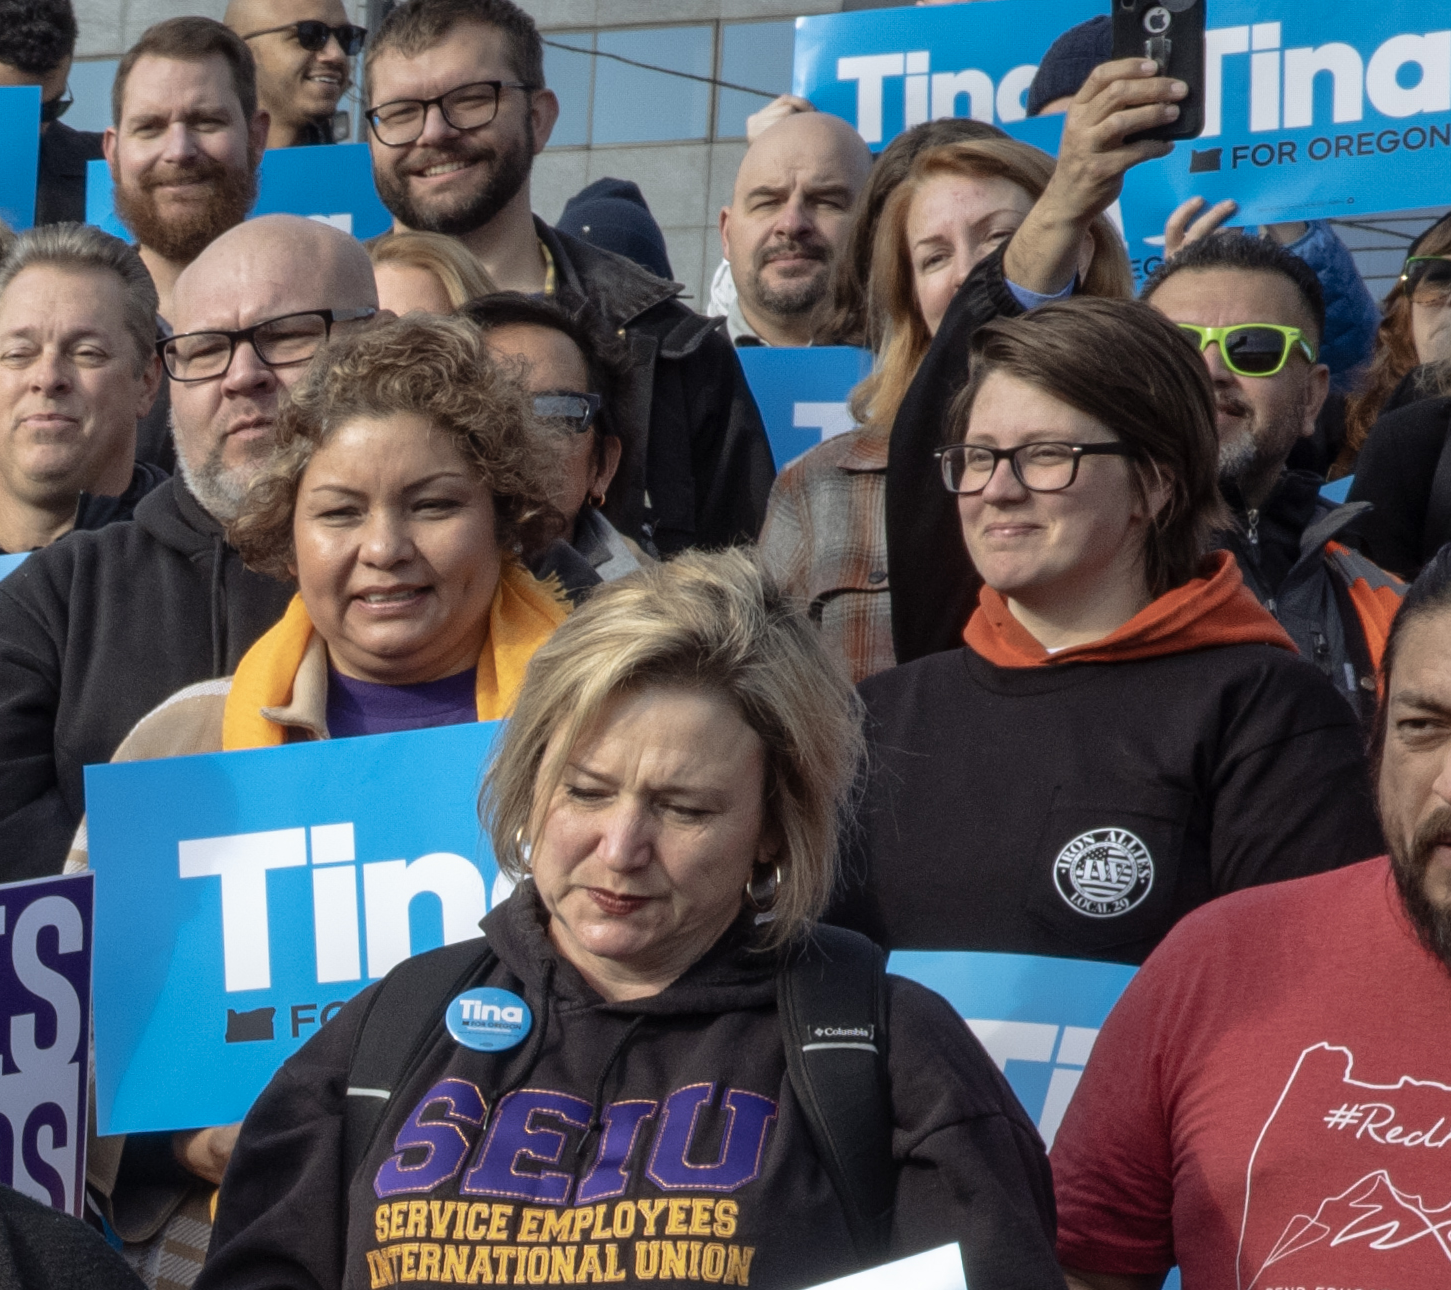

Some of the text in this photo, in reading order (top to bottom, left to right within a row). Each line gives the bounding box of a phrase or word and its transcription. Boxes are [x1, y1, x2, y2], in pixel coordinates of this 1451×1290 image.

[1233, 125, 1451, 169] FOR OREGON
[1057, 830, 1151, 879] IRON ALLIES
[179, 821, 516, 990] Tin
[1070, 892, 1111, 913] LOCAL
[459, 1000, 523, 1023] Tina
[373, 1077, 780, 1207] SEIU
[374, 1198, 740, 1243] SERVICE EMPLOYEES
[365, 1240, 757, 1290] INTERNATIONAL UNION
